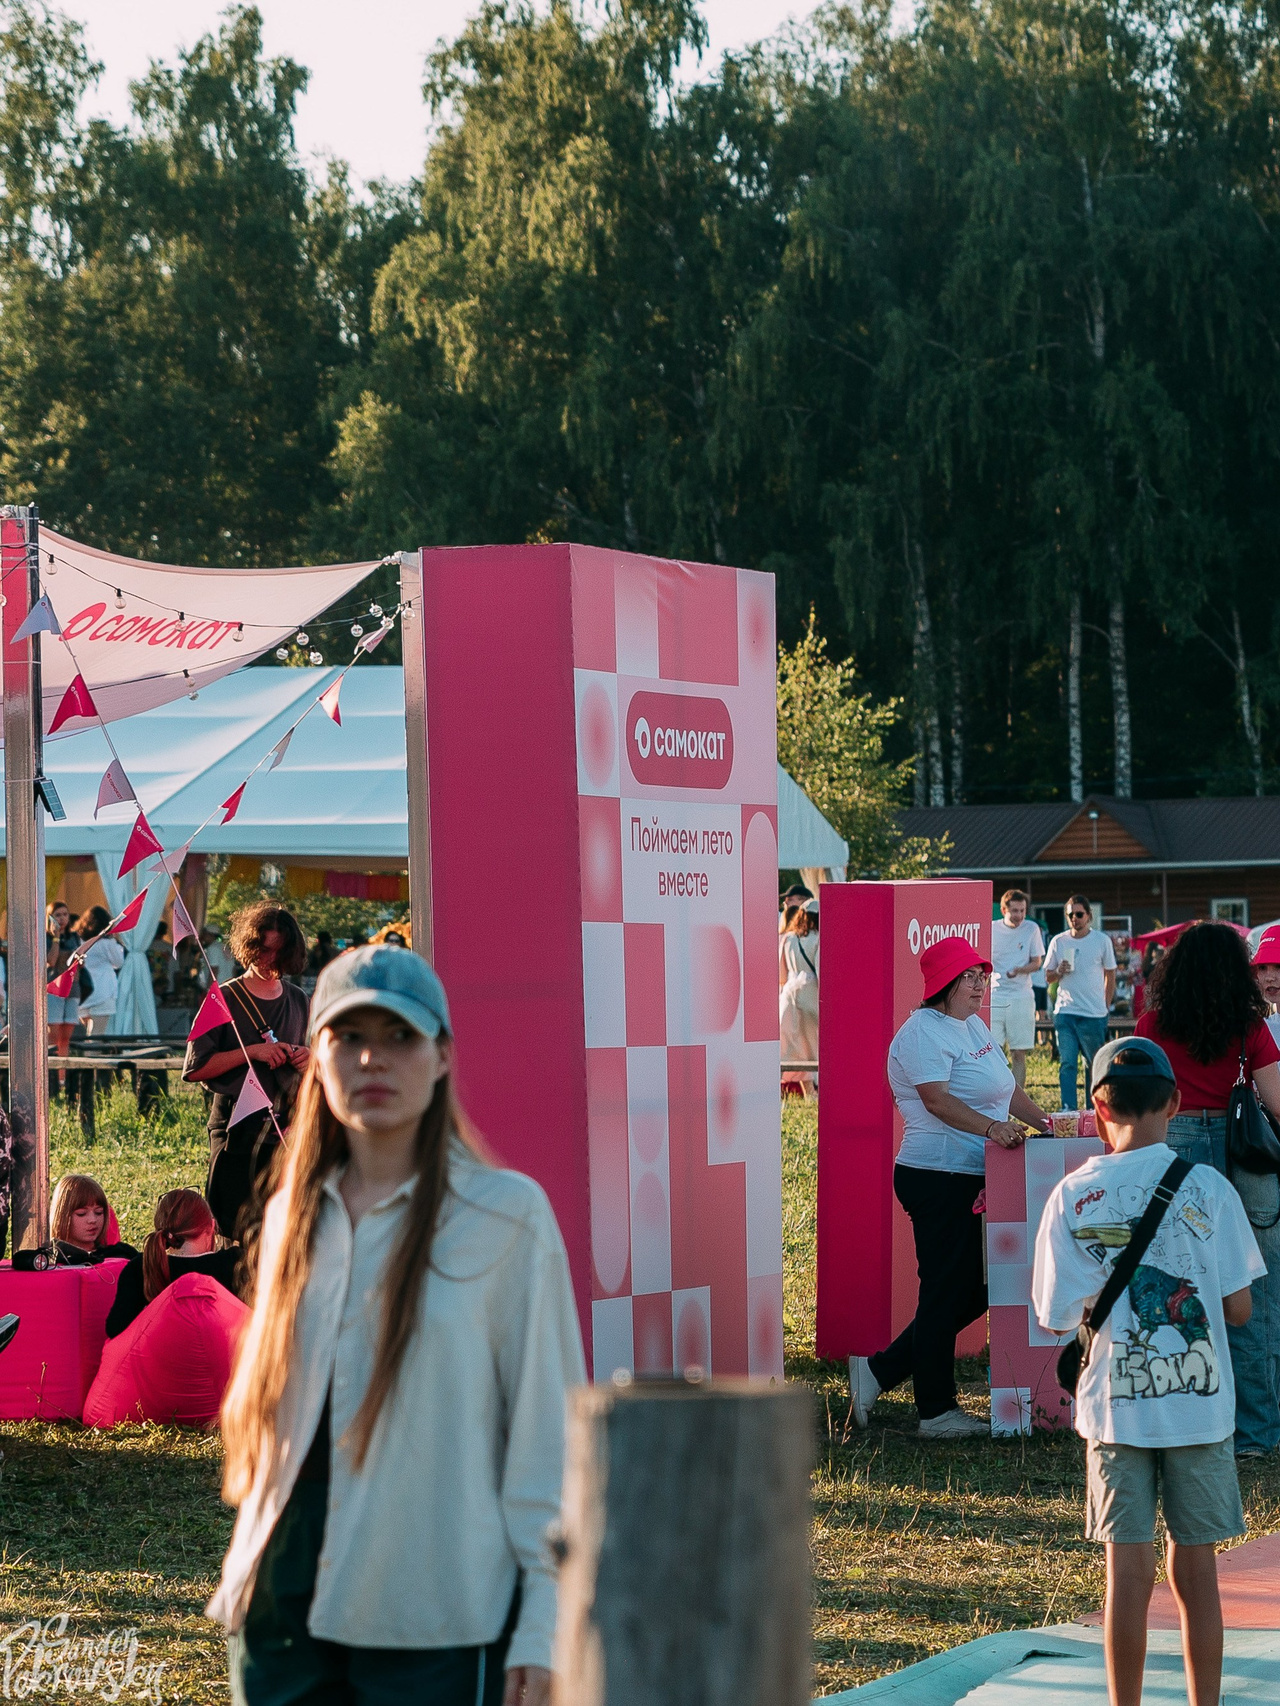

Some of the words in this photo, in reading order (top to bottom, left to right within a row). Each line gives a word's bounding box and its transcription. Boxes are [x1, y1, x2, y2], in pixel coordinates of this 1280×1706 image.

[89, 614, 243, 650] самокат
[654, 727, 726, 761] самокат
[631, 816, 699, 854] Поймаем
[701, 830, 734, 856] лето
[658, 871, 709, 897] вместе
